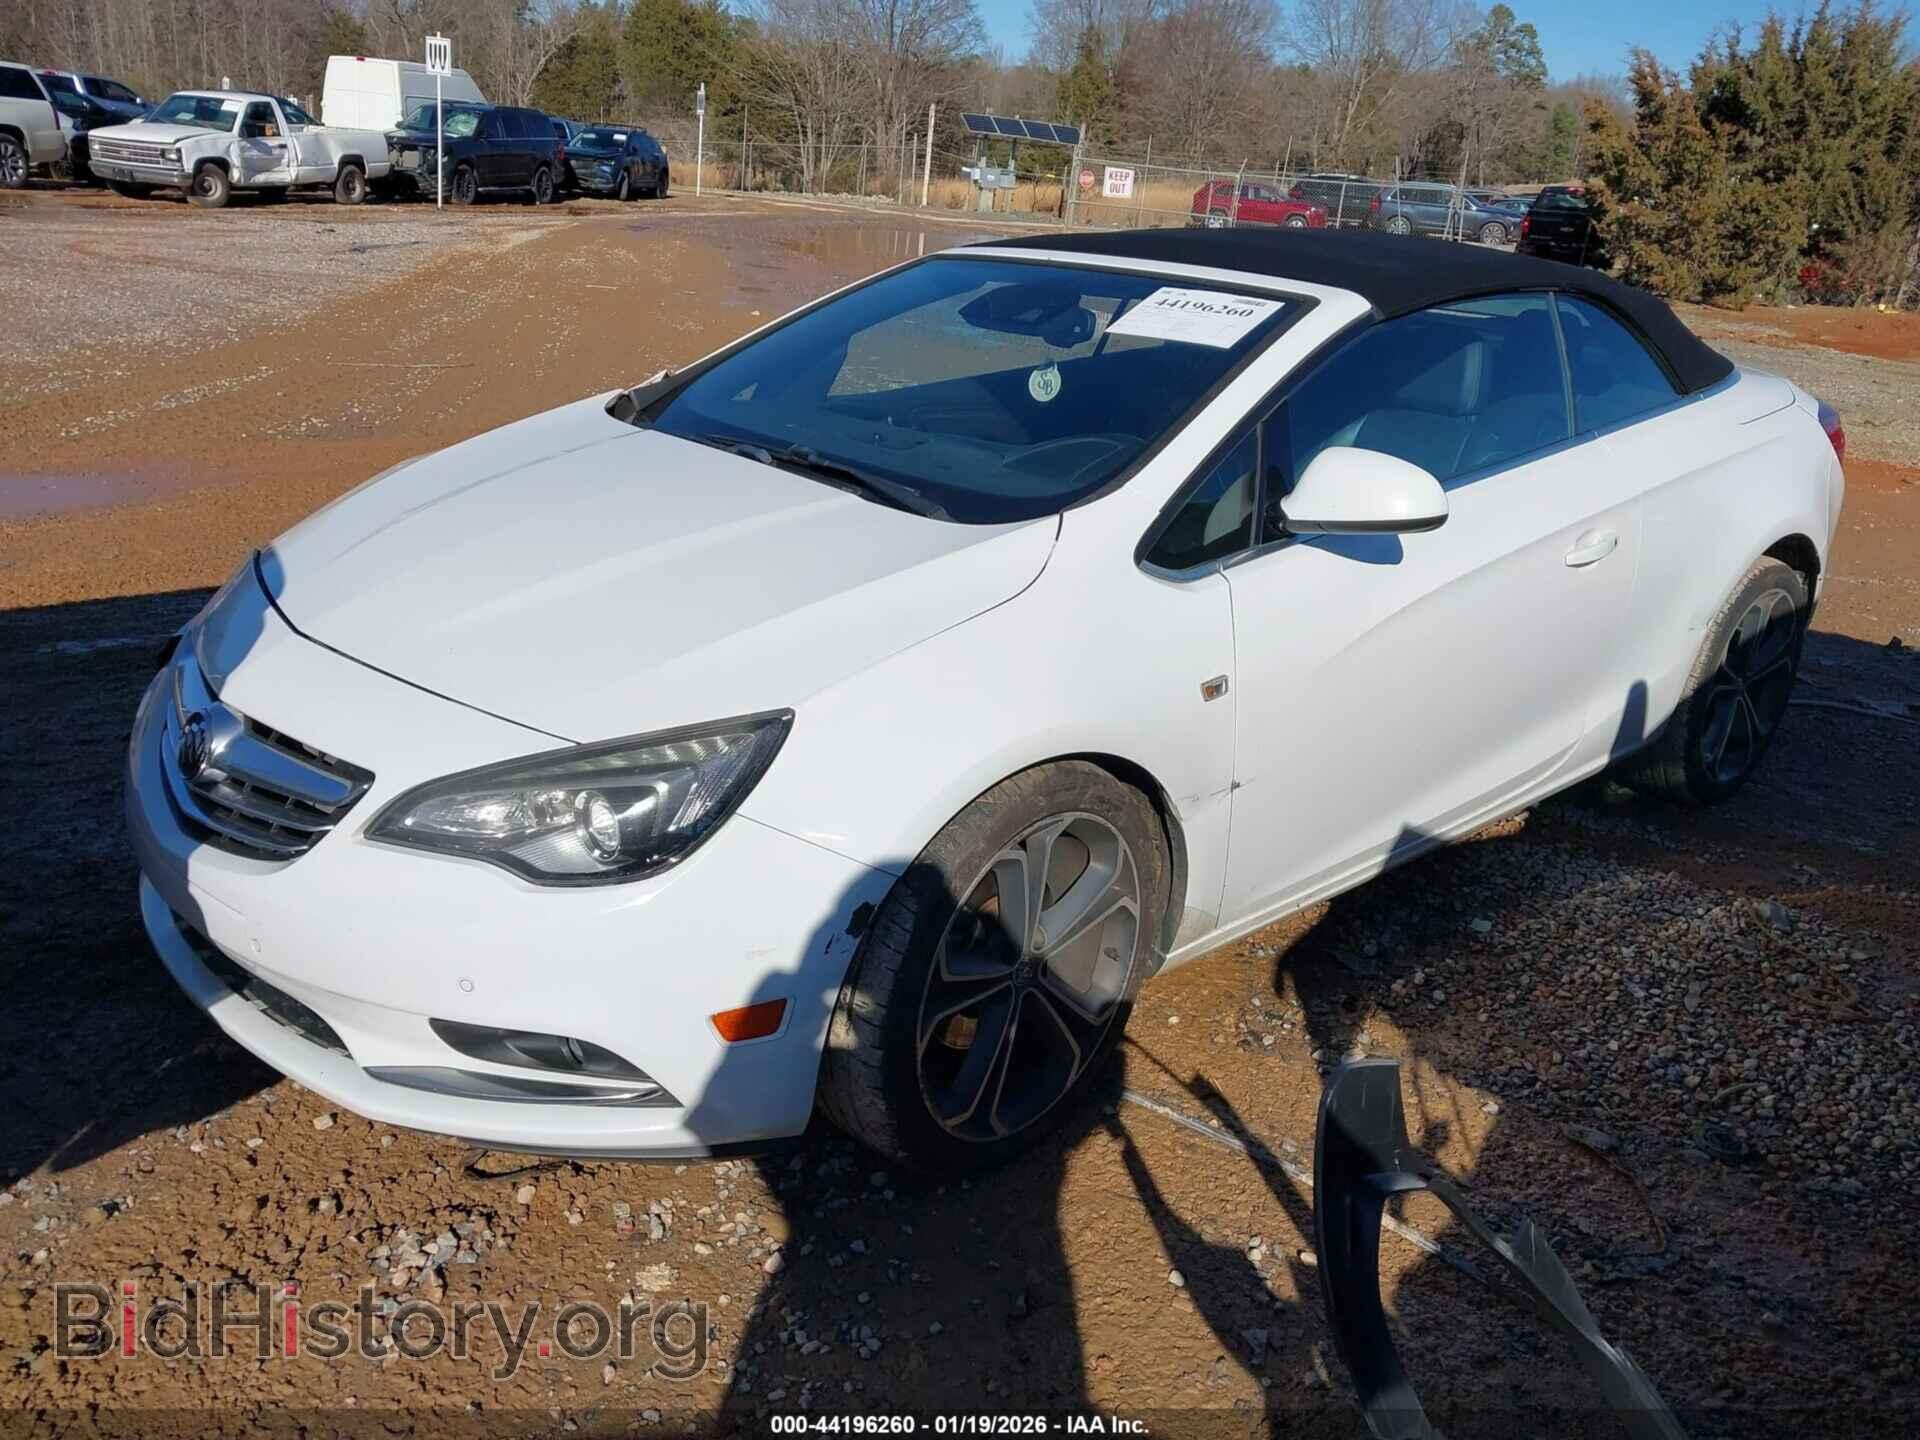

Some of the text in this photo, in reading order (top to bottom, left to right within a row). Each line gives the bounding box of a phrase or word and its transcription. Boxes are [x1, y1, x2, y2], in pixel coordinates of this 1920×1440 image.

[1109, 170, 1130, 181] KEEP
[1109, 182, 1126, 193] OUT
[1154, 297, 1254, 318] 44196260
